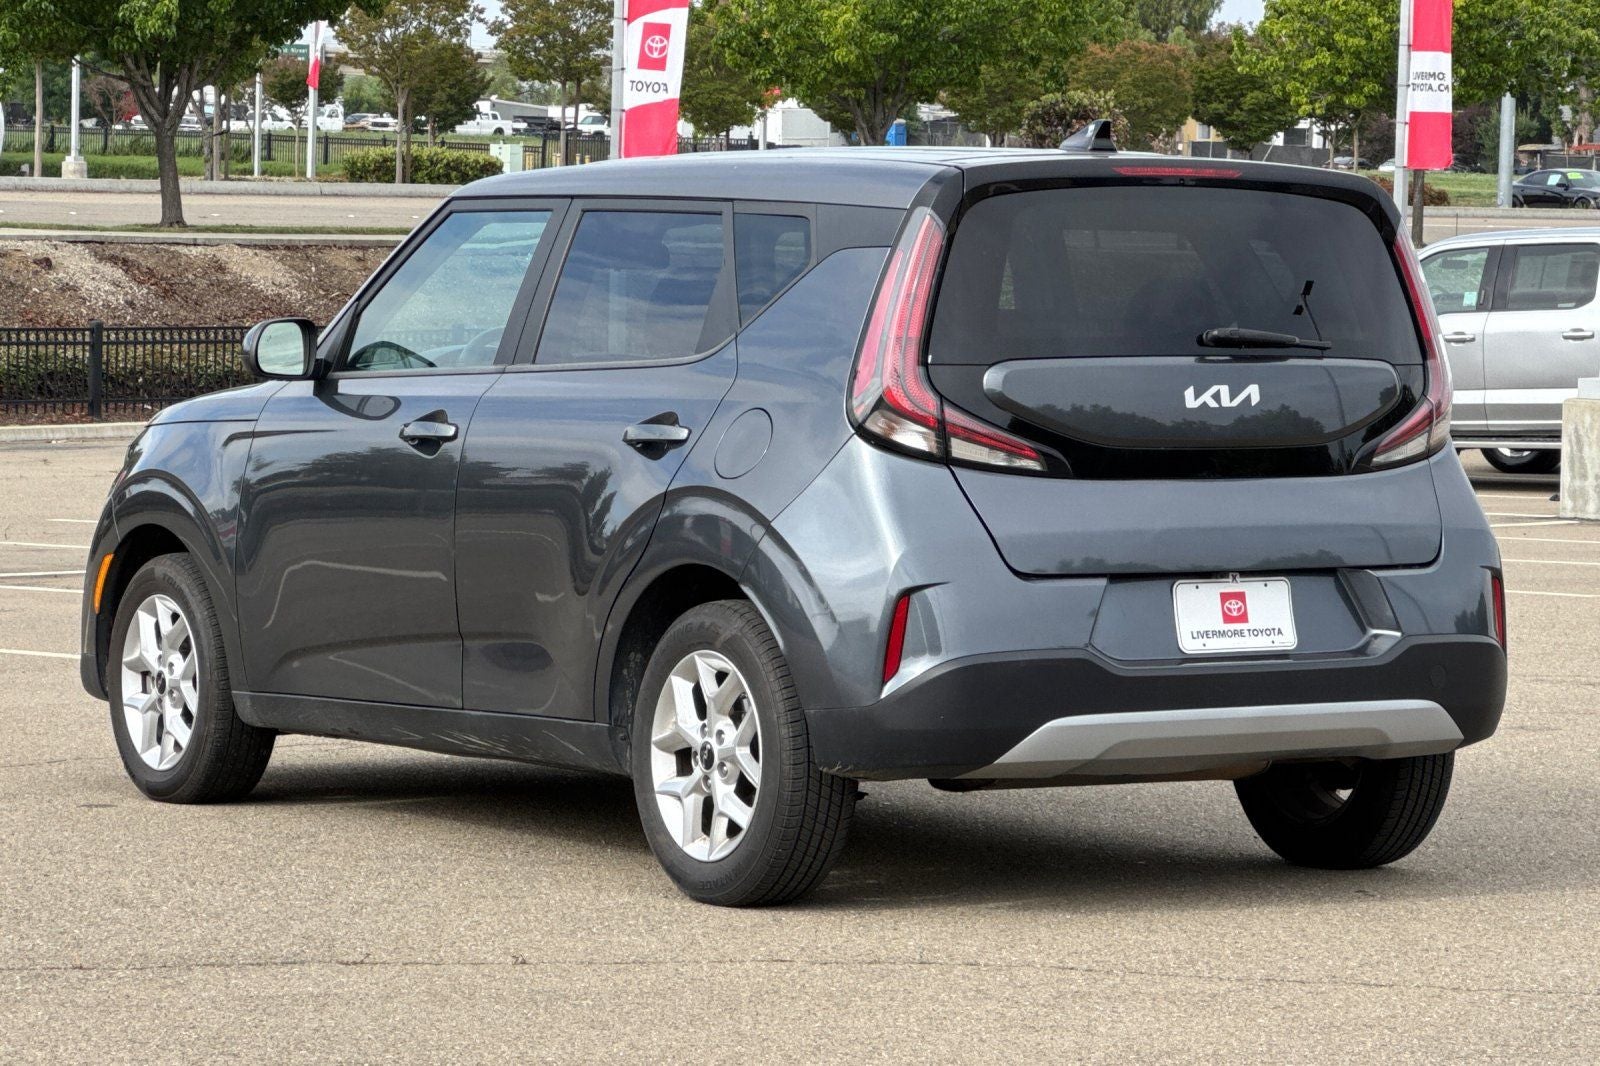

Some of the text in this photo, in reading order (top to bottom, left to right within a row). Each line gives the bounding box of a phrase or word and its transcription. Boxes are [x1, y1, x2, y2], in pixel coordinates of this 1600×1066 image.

[1184, 383, 1261, 408] KIA
[1190, 627, 1284, 640] LIVERMORE TOYOTA
